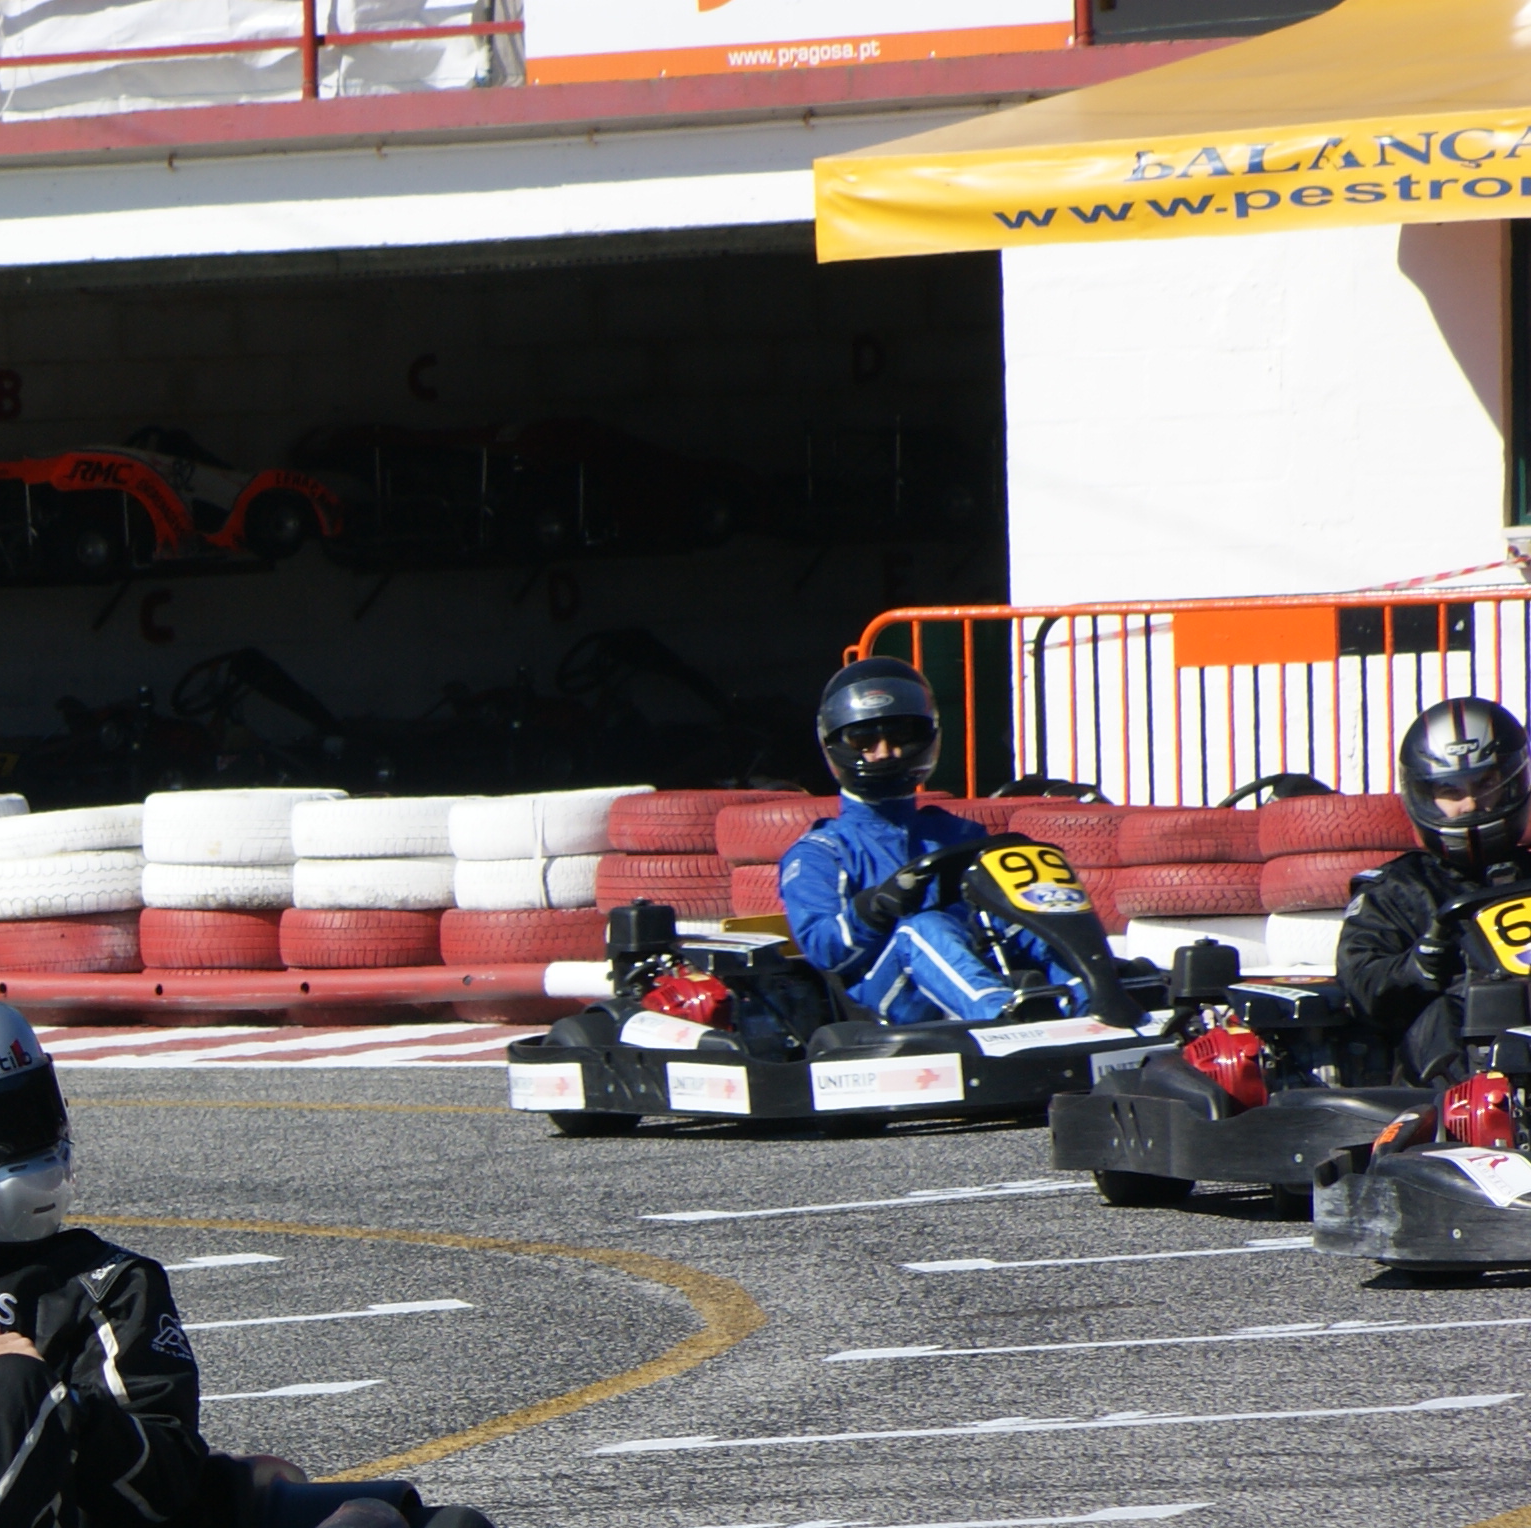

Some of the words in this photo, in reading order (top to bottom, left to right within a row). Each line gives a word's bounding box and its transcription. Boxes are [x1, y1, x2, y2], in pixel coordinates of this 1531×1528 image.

[727, 39, 881, 67] www.pragosa.pt
[999, 849, 1077, 890] 99
[817, 1072, 877, 1091] UNITRIP
